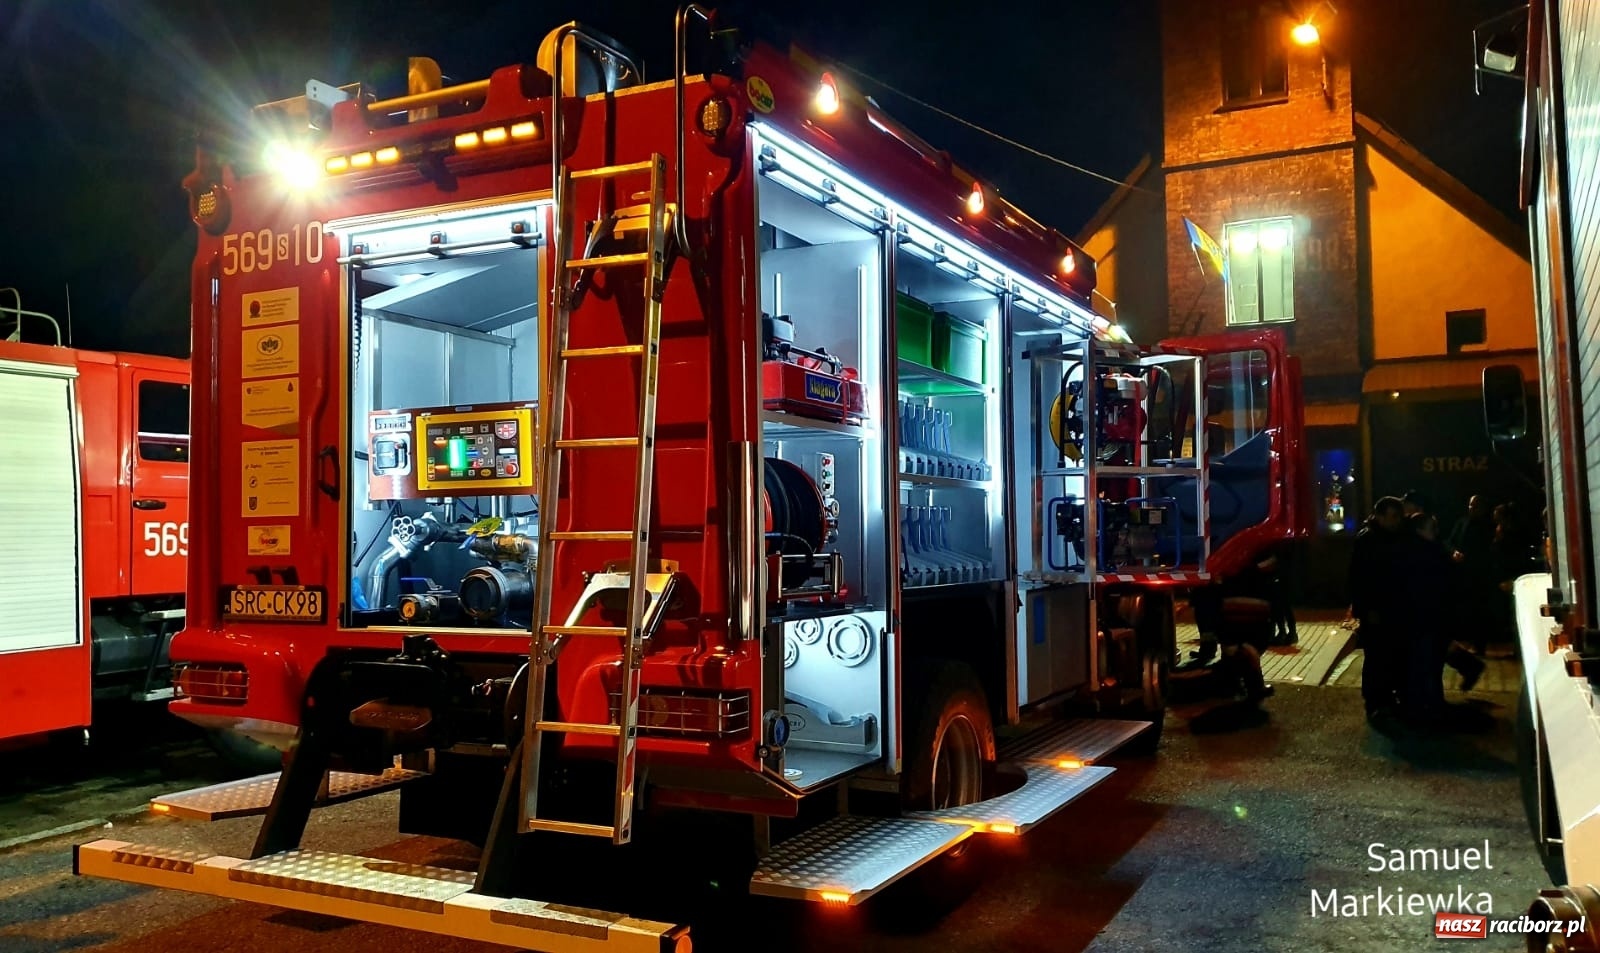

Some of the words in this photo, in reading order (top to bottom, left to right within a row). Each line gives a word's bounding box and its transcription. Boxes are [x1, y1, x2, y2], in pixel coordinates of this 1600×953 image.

[144, 521, 189, 557] 569
[234, 590, 267, 614] SRC
[273, 591, 318, 615] CK98
